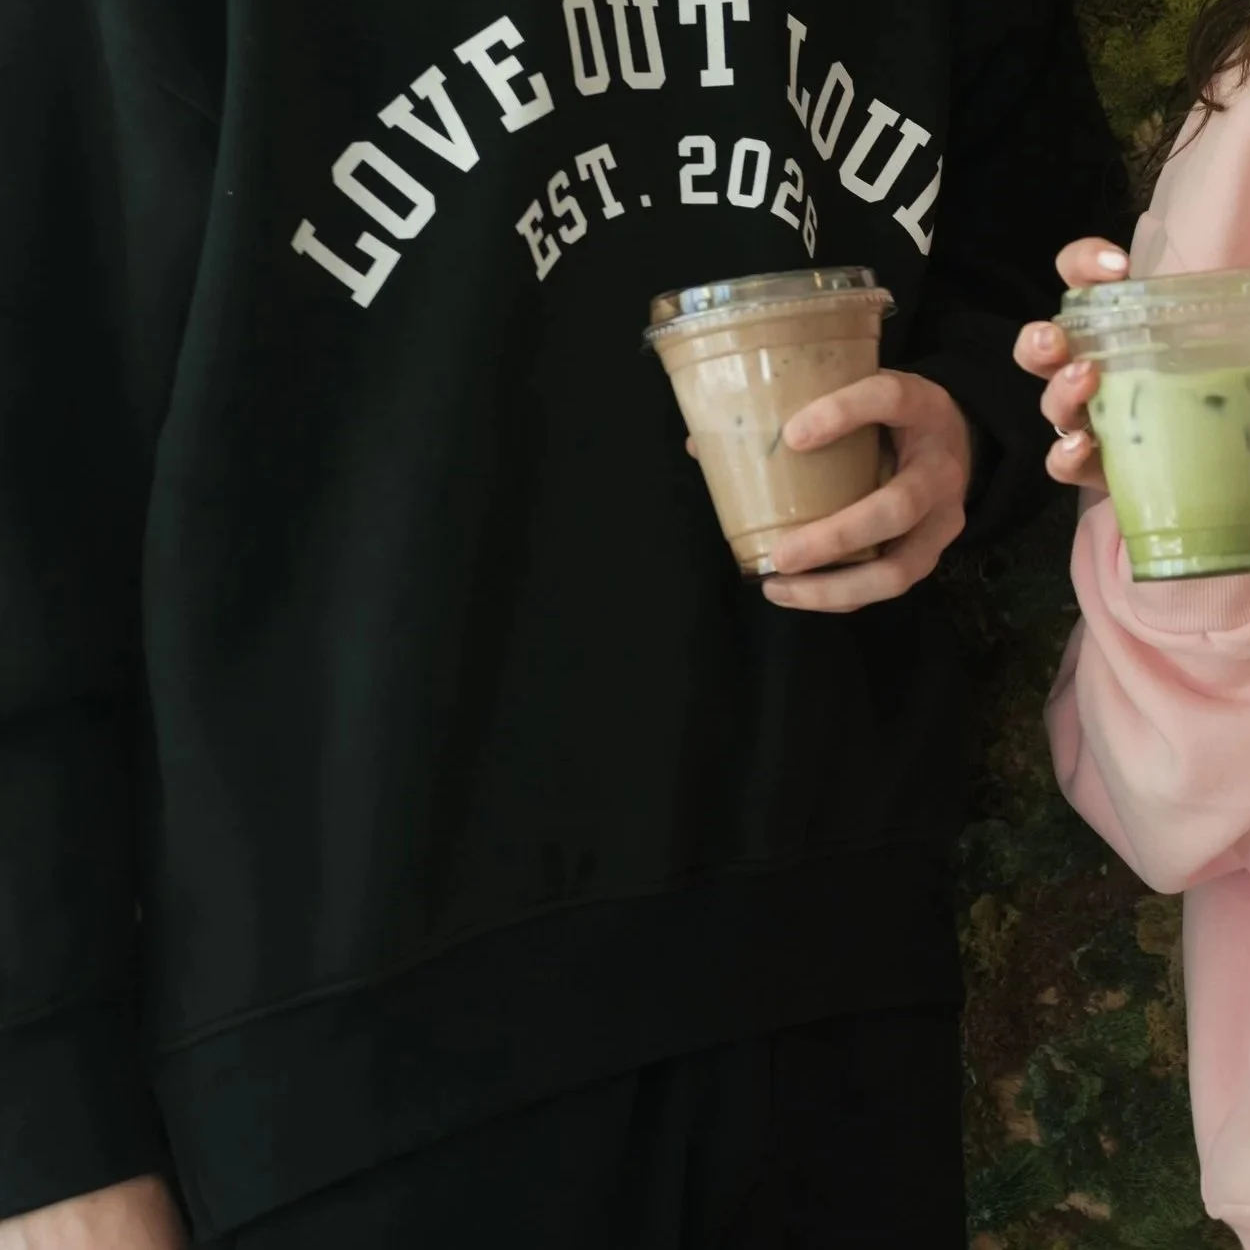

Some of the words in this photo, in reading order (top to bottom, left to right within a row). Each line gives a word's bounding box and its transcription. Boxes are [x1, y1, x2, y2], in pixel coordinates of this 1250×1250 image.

[290, 14, 555, 309] LOVE
[514, 143, 652, 282] EST.
[677, 134, 818, 260] 2026
